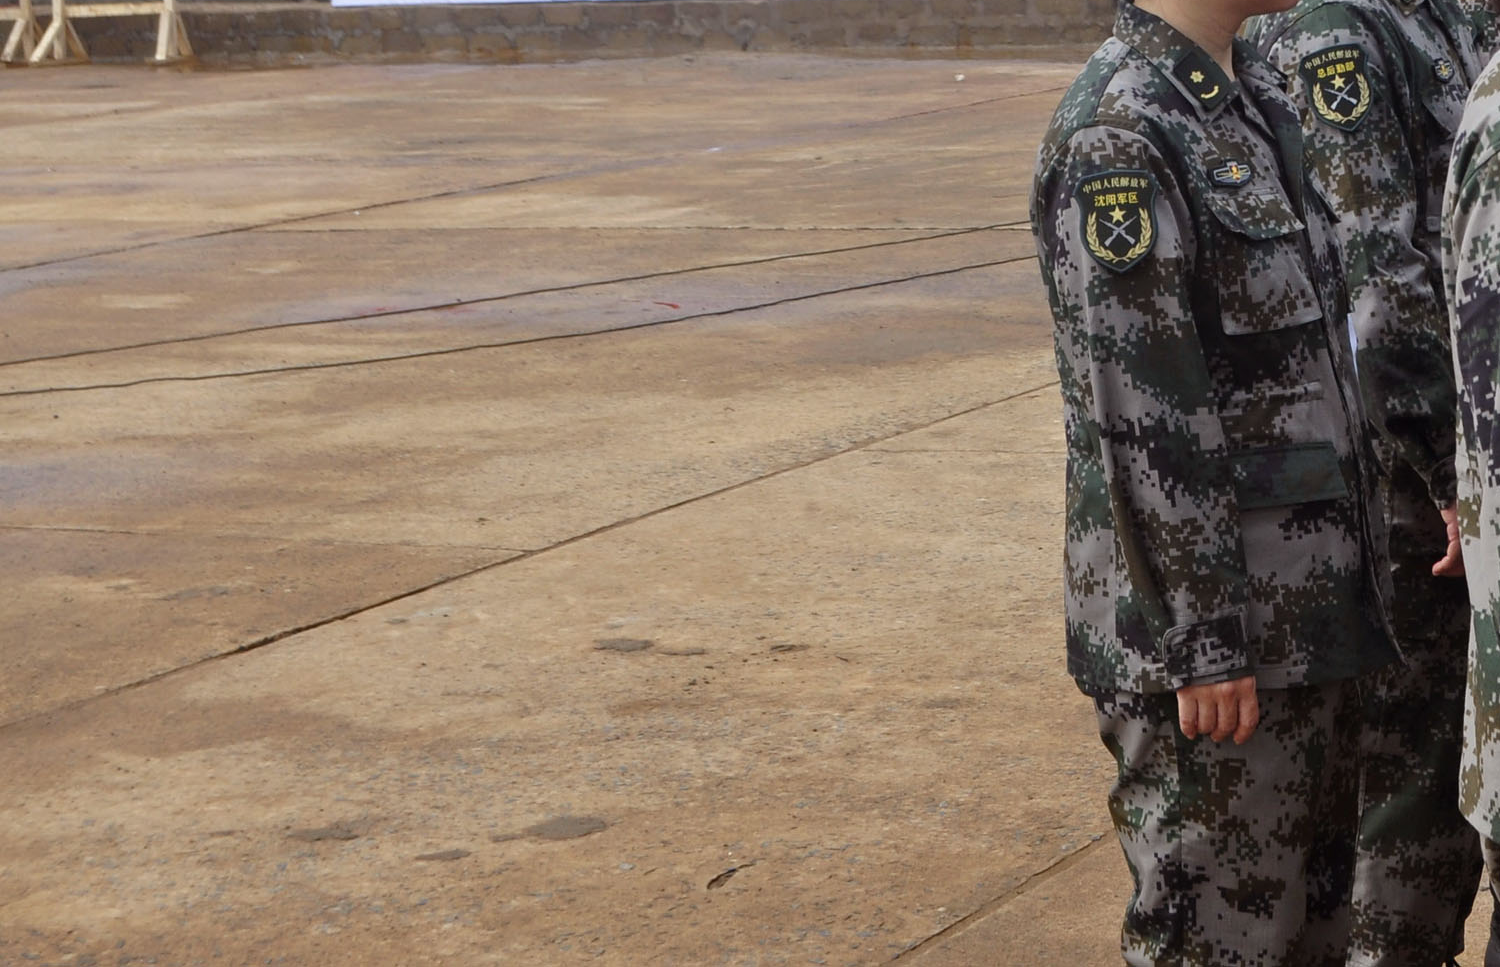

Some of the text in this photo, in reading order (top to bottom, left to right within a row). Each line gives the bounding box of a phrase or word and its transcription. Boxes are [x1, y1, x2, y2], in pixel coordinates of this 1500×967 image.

[1304, 49, 1360, 70] 中国人民解放军
[1082, 176, 1149, 194] 中国人民解放军
[1093, 191, 1139, 207] 沈阳军区
